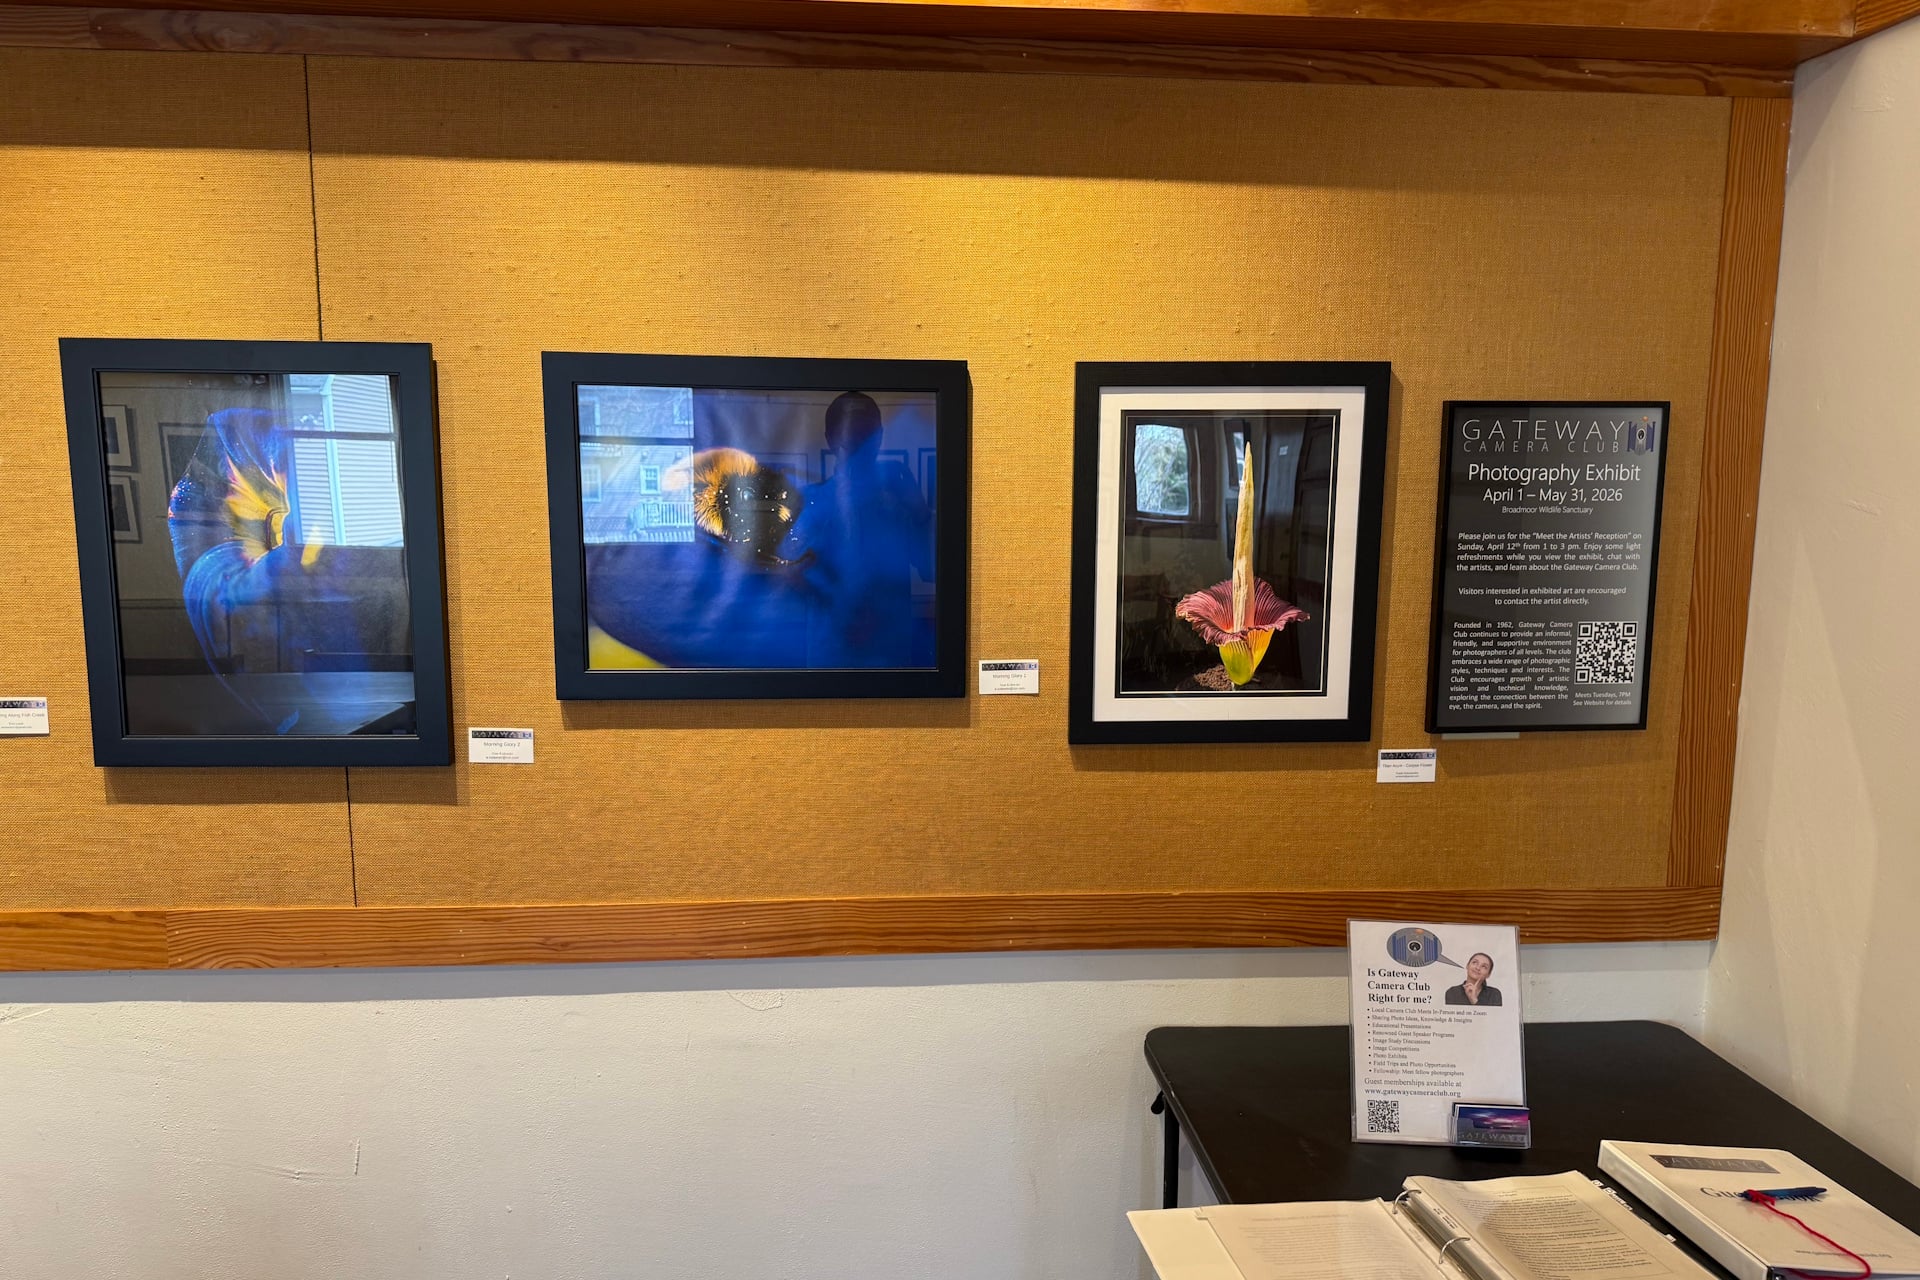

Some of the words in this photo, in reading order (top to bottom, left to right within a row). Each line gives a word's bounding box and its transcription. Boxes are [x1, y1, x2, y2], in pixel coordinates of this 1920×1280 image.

[1462, 419, 1625, 440] GATEWAY
[1463, 441, 1549, 453] CAMERA
[1567, 441, 1619, 453] CLUB
[1468, 463, 1581, 485] Photography
[1585, 463, 1641, 481] Exhibit
[1483, 488, 1514, 504] April
[1517, 488, 1523, 501] 1
[1539, 488, 1567, 504] May
[1571, 488, 1587, 503] 31,
[1591, 488, 1623, 501] 2026
[1501, 506, 1537, 514] Broadmoor
[1538, 506, 1562, 514] Wildlife
[1562, 506, 1593, 515] Sanctuary
[1482, 532, 1496, 541] join
[1457, 543, 1484, 552] Sunday,
[1487, 543, 1504, 552] April
[1584, 542, 1602, 551] Enjoy
[1626, 542, 1641, 551] light
[1579, 553, 1604, 562] exhibit,
[1470, 564, 1493, 572] artists,
[1563, 563, 1593, 572] Gateway
[1587, 587, 1626, 596] encouraged
[1563, 598, 1589, 606] directly.
[1497, 621, 1513, 630] 1962,
[1518, 621, 1545, 630] Gateway
[1510, 630, 1533, 639] provide
[1545, 630, 1572, 638] informal,
[1453, 639, 1478, 648] friendly,
[1497, 639, 1530, 648] supportive
[1462, 648, 1508, 657] photographers
[1530, 657, 1571, 666] photographic
[1451, 666, 1470, 675] styles,
[1474, 666, 1508, 675] techniques
[1510, 675, 1532, 684] growth
[1534, 684, 1569, 692] knowledge,
[1450, 693, 1478, 702] exploring
[1525, 702, 1542, 710] spirit.
[1367, 968, 1376, 977] Is
[1378, 969, 1419, 980] Gateway
[1367, 981, 1405, 990] Camera
[1407, 982, 1430, 991] Club
[1368, 994, 1394, 1004] Right
[1396, 995, 1410, 1003] for
[1413, 995, 1432, 1004] me?
[1384, 1078, 1425, 1088] memberships
[1365, 1089, 1461, 1097] www.gatewaycameraclub.org
